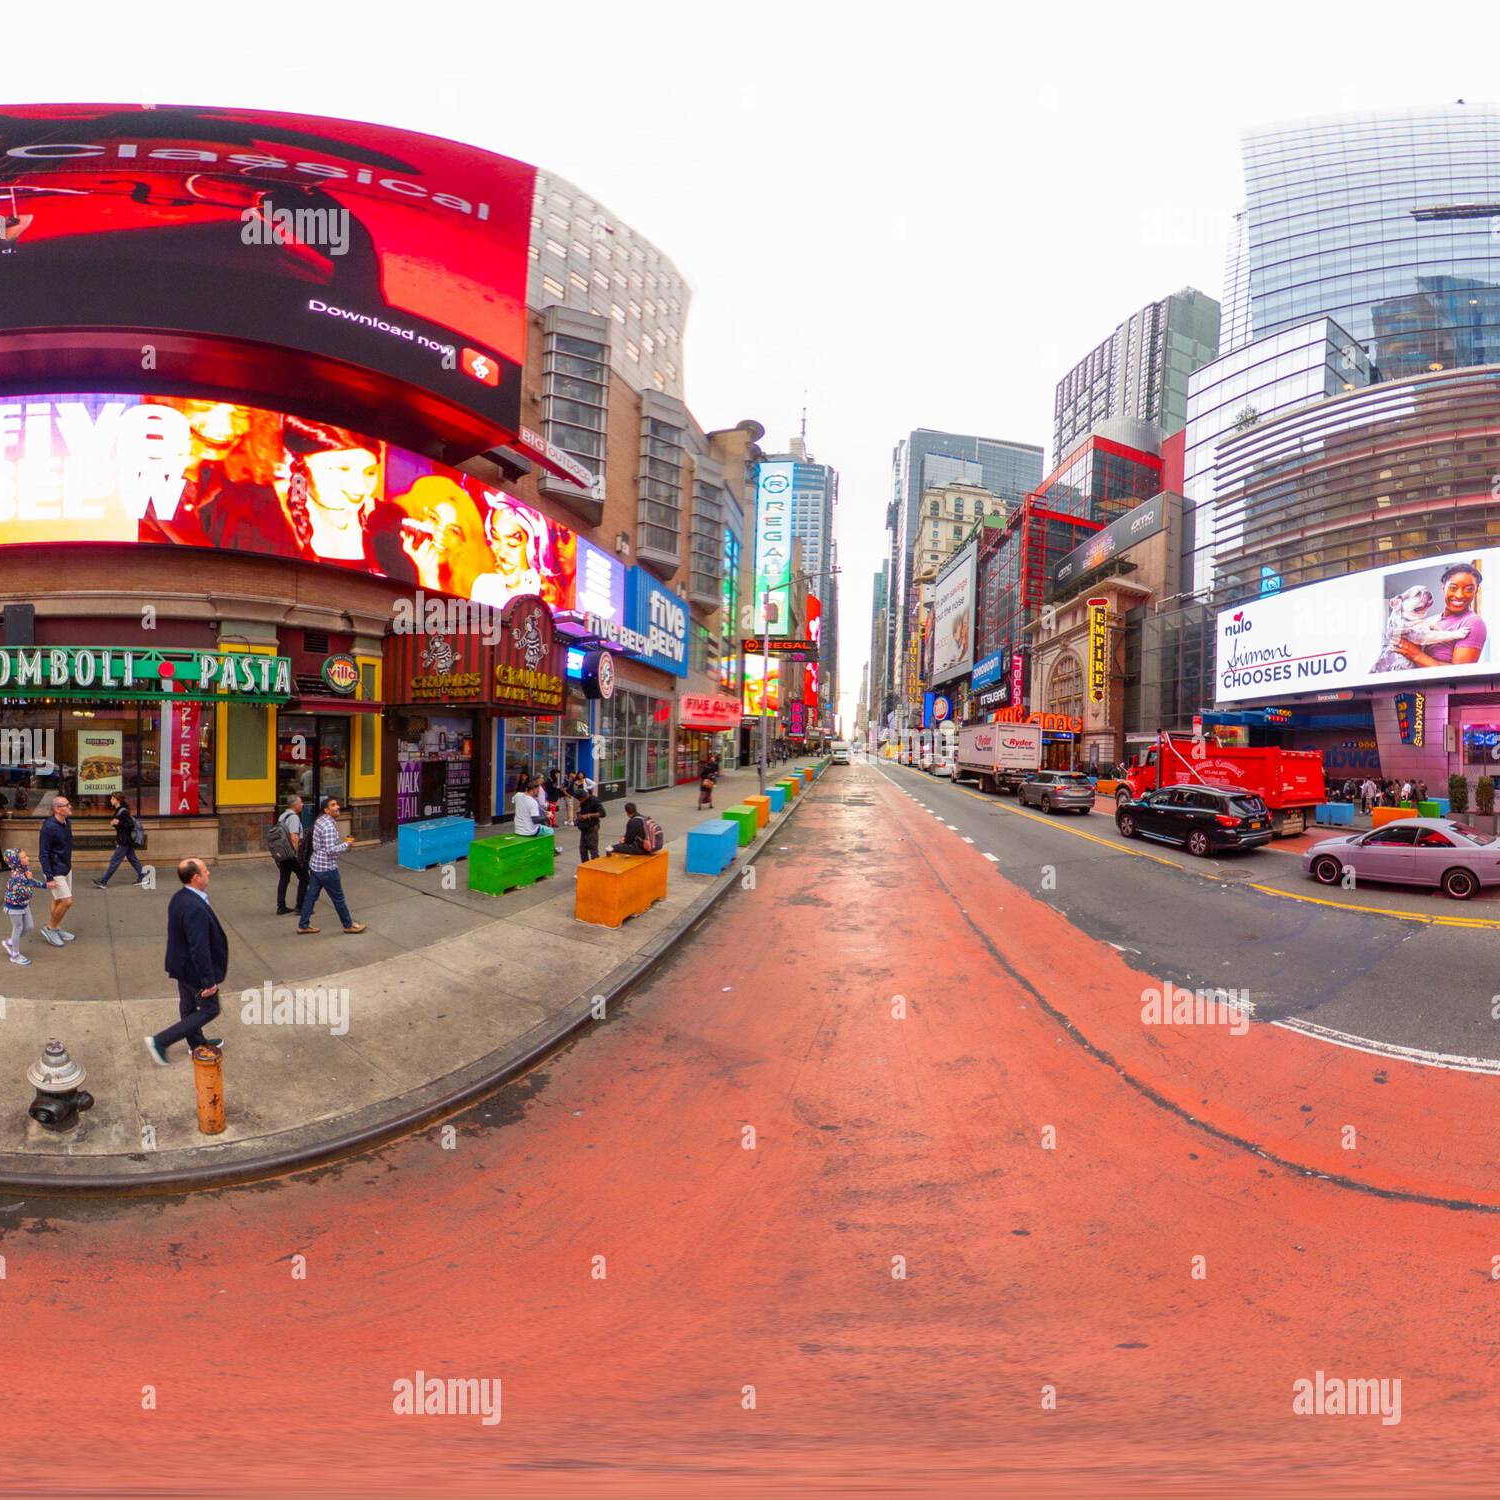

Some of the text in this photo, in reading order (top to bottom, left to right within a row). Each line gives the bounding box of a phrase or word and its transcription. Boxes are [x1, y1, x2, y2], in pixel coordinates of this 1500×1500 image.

[6, 144, 488, 220] Classical
[308, 299, 454, 357] Download now
[521, 428, 546, 452] BIG
[650, 590, 685, 639] five
[1225, 617, 1252, 636] nulo
[765, 641, 810, 650] REGAL
[1096, 612, 1105, 684] EMPIRE
[200, 656, 290, 692] PASTA
[327, 665, 358, 681] villa
[412, 672, 481, 688] CRUMBS
[1223, 656, 1347, 688] CHOOSES NULO
[686, 697, 710, 711] FIVE
[1027, 711, 1083, 732] amc
[1413, 692, 1425, 747] Subway
[1010, 737, 1033, 747] Ryder
